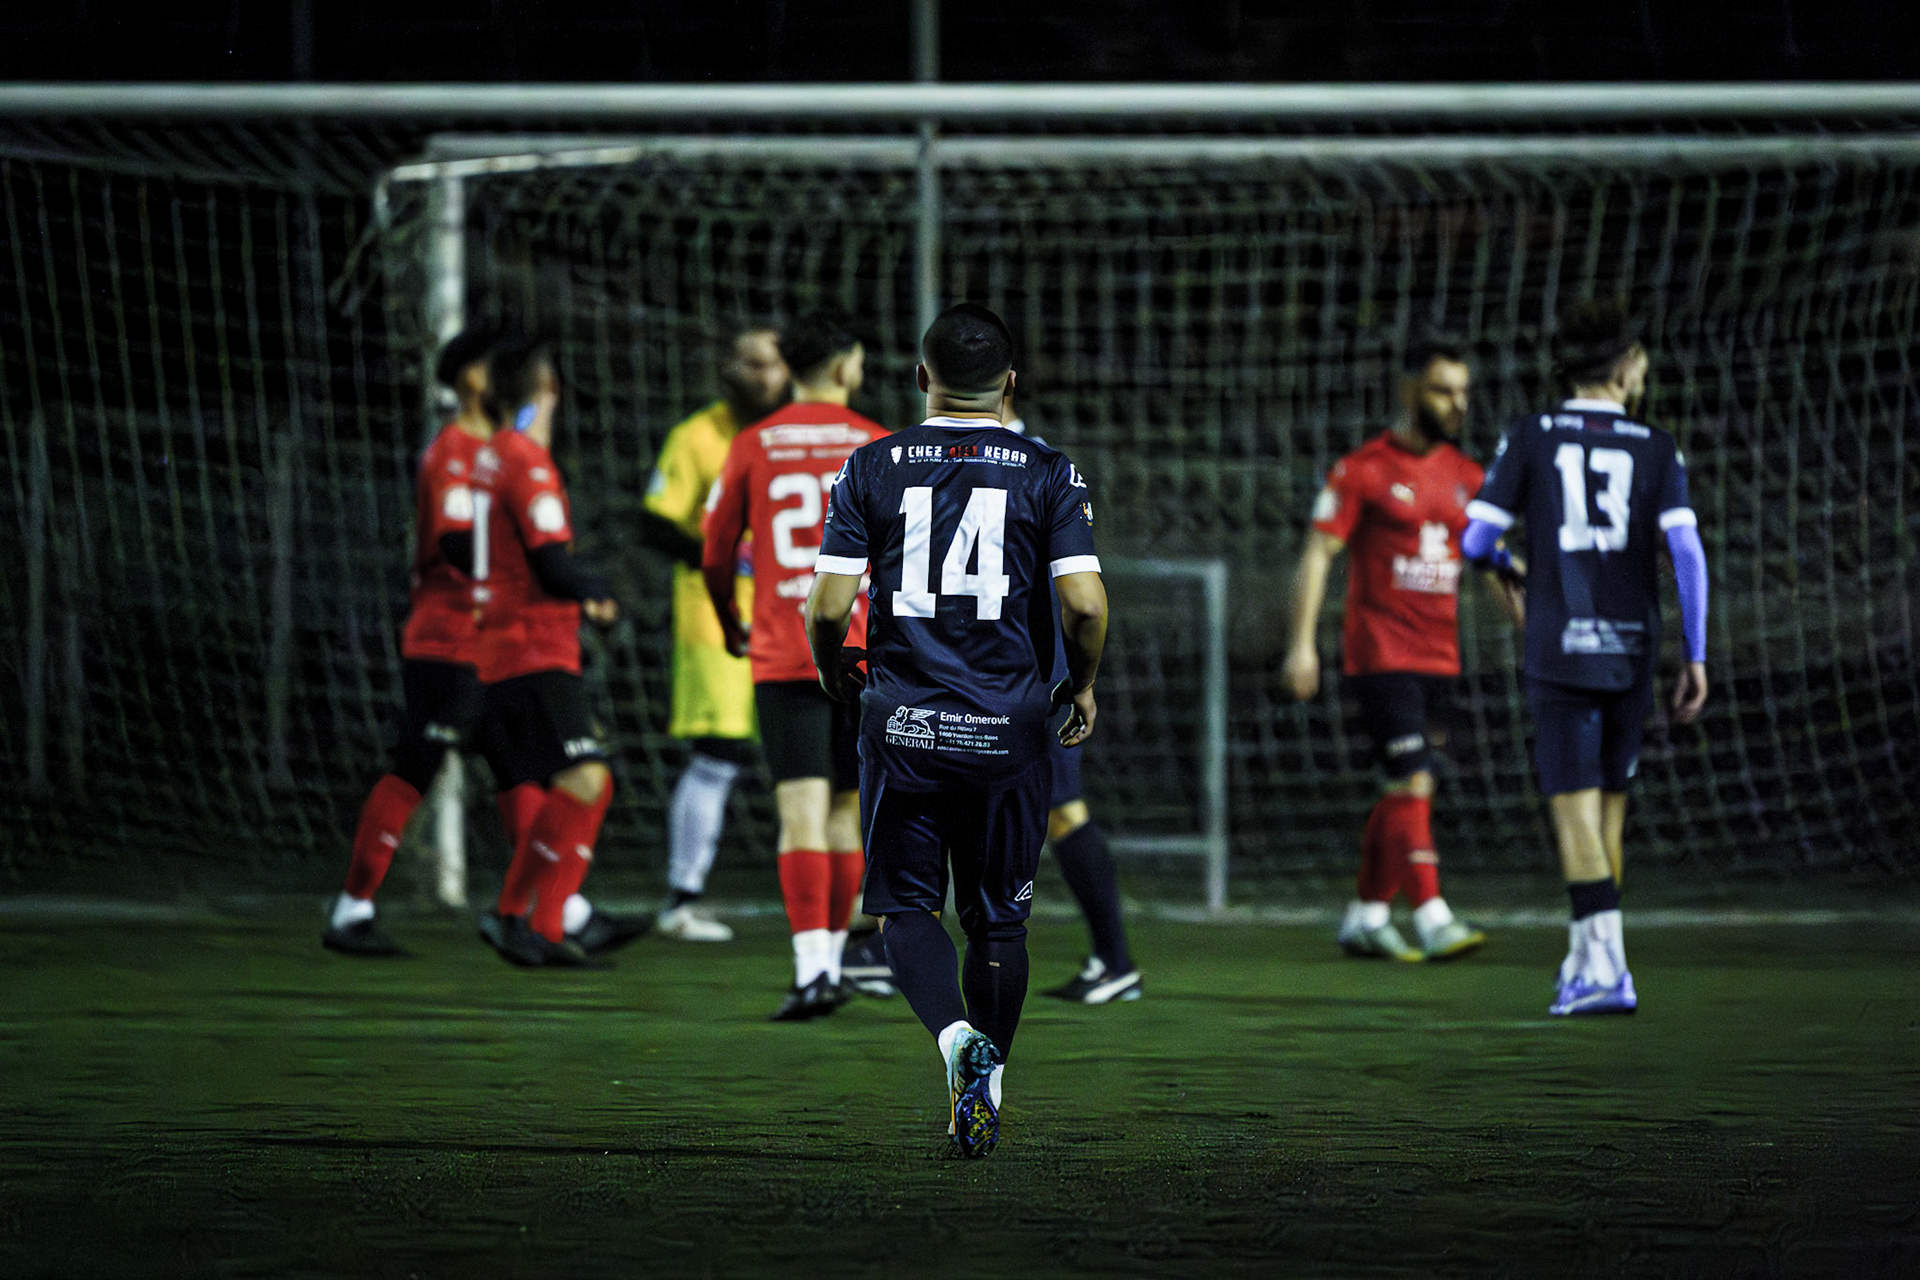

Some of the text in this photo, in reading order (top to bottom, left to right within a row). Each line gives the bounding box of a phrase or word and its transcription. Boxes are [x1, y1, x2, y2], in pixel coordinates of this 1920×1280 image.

[908, 445, 942, 458] CHEZ
[984, 445, 1027, 464] KEBAB
[893, 486, 1010, 620] 14
[940, 711, 1010, 725] Emir Omerovic
[885, 734, 935, 750] GENERALI
